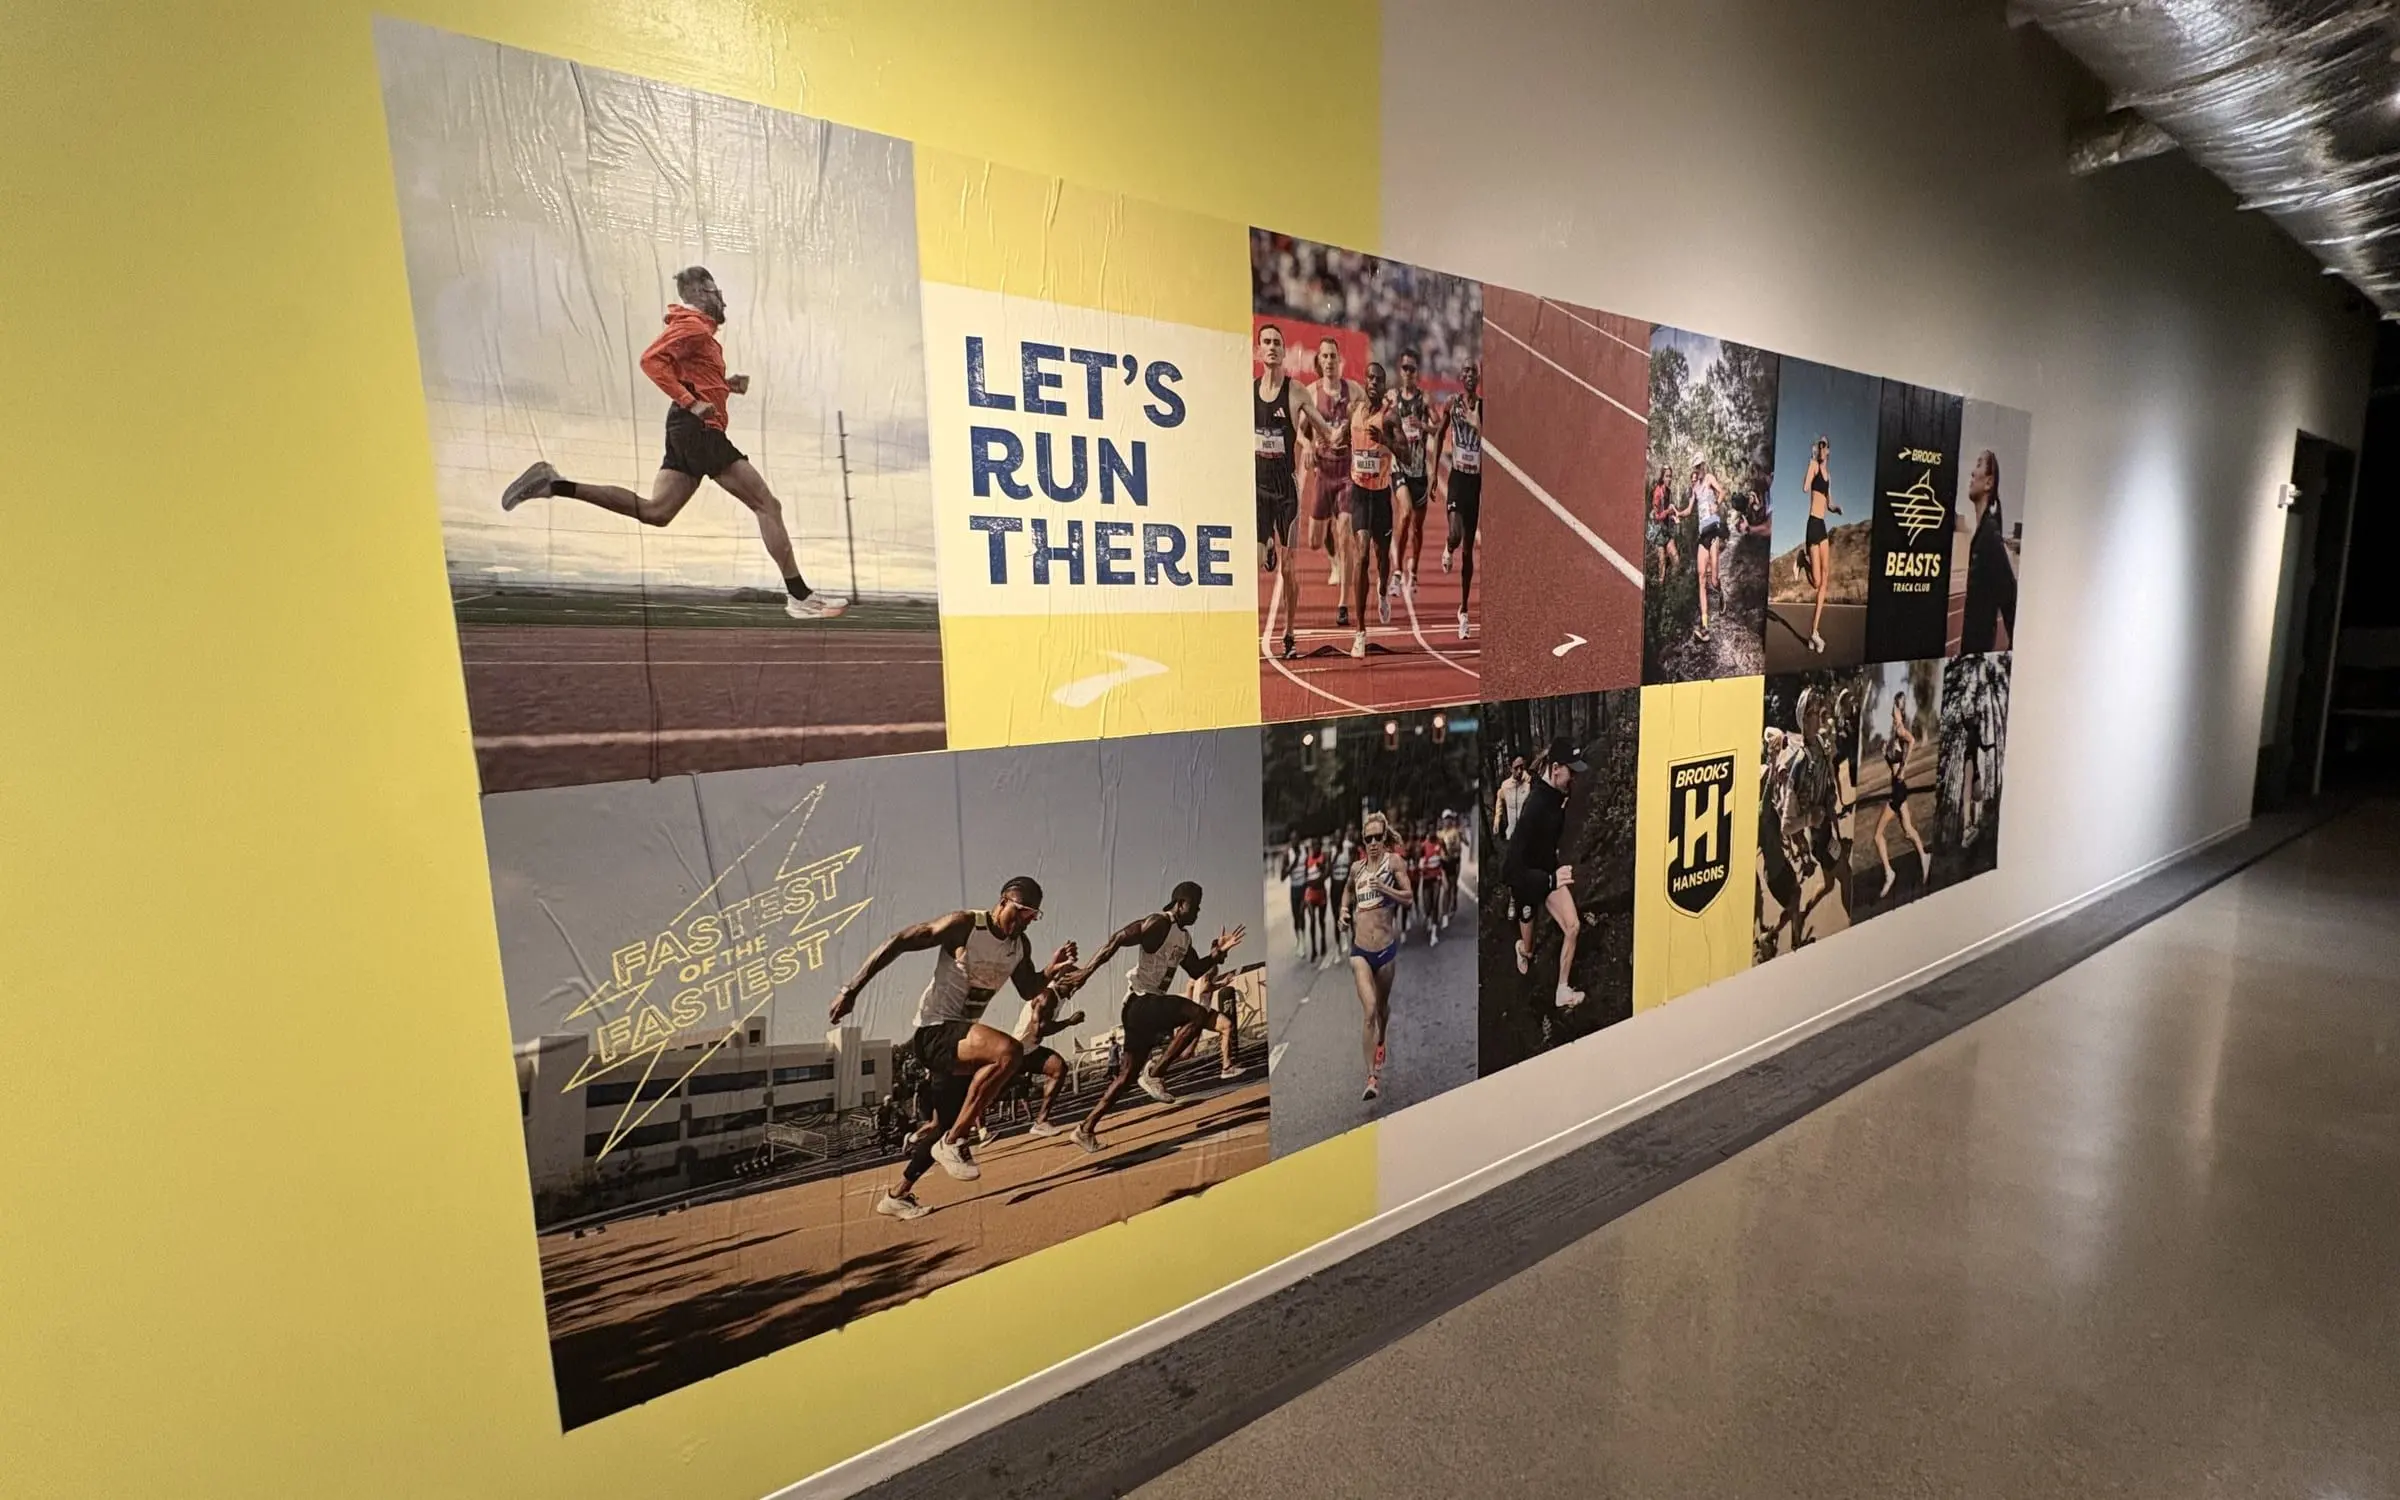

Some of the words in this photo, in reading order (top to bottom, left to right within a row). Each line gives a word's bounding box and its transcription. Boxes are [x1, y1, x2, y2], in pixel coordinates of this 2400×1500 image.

[966, 336, 1186, 428] LET'S
[970, 426, 1148, 506] RUN
[1912, 449, 1942, 464] BROOKS
[969, 516, 1233, 587] THERE
[1885, 551, 1941, 577] BEASTS
[1893, 583, 1913, 592] TRACK
[1914, 583, 1930, 592] CLUB
[1675, 762, 1729, 788] BROOKS
[1673, 865, 1724, 892] HANSONS
[612, 861, 843, 989] FASTEST
[679, 955, 717, 983] OF
[720, 933, 769, 966] THE
[597, 930, 829, 1064] FASTEST
